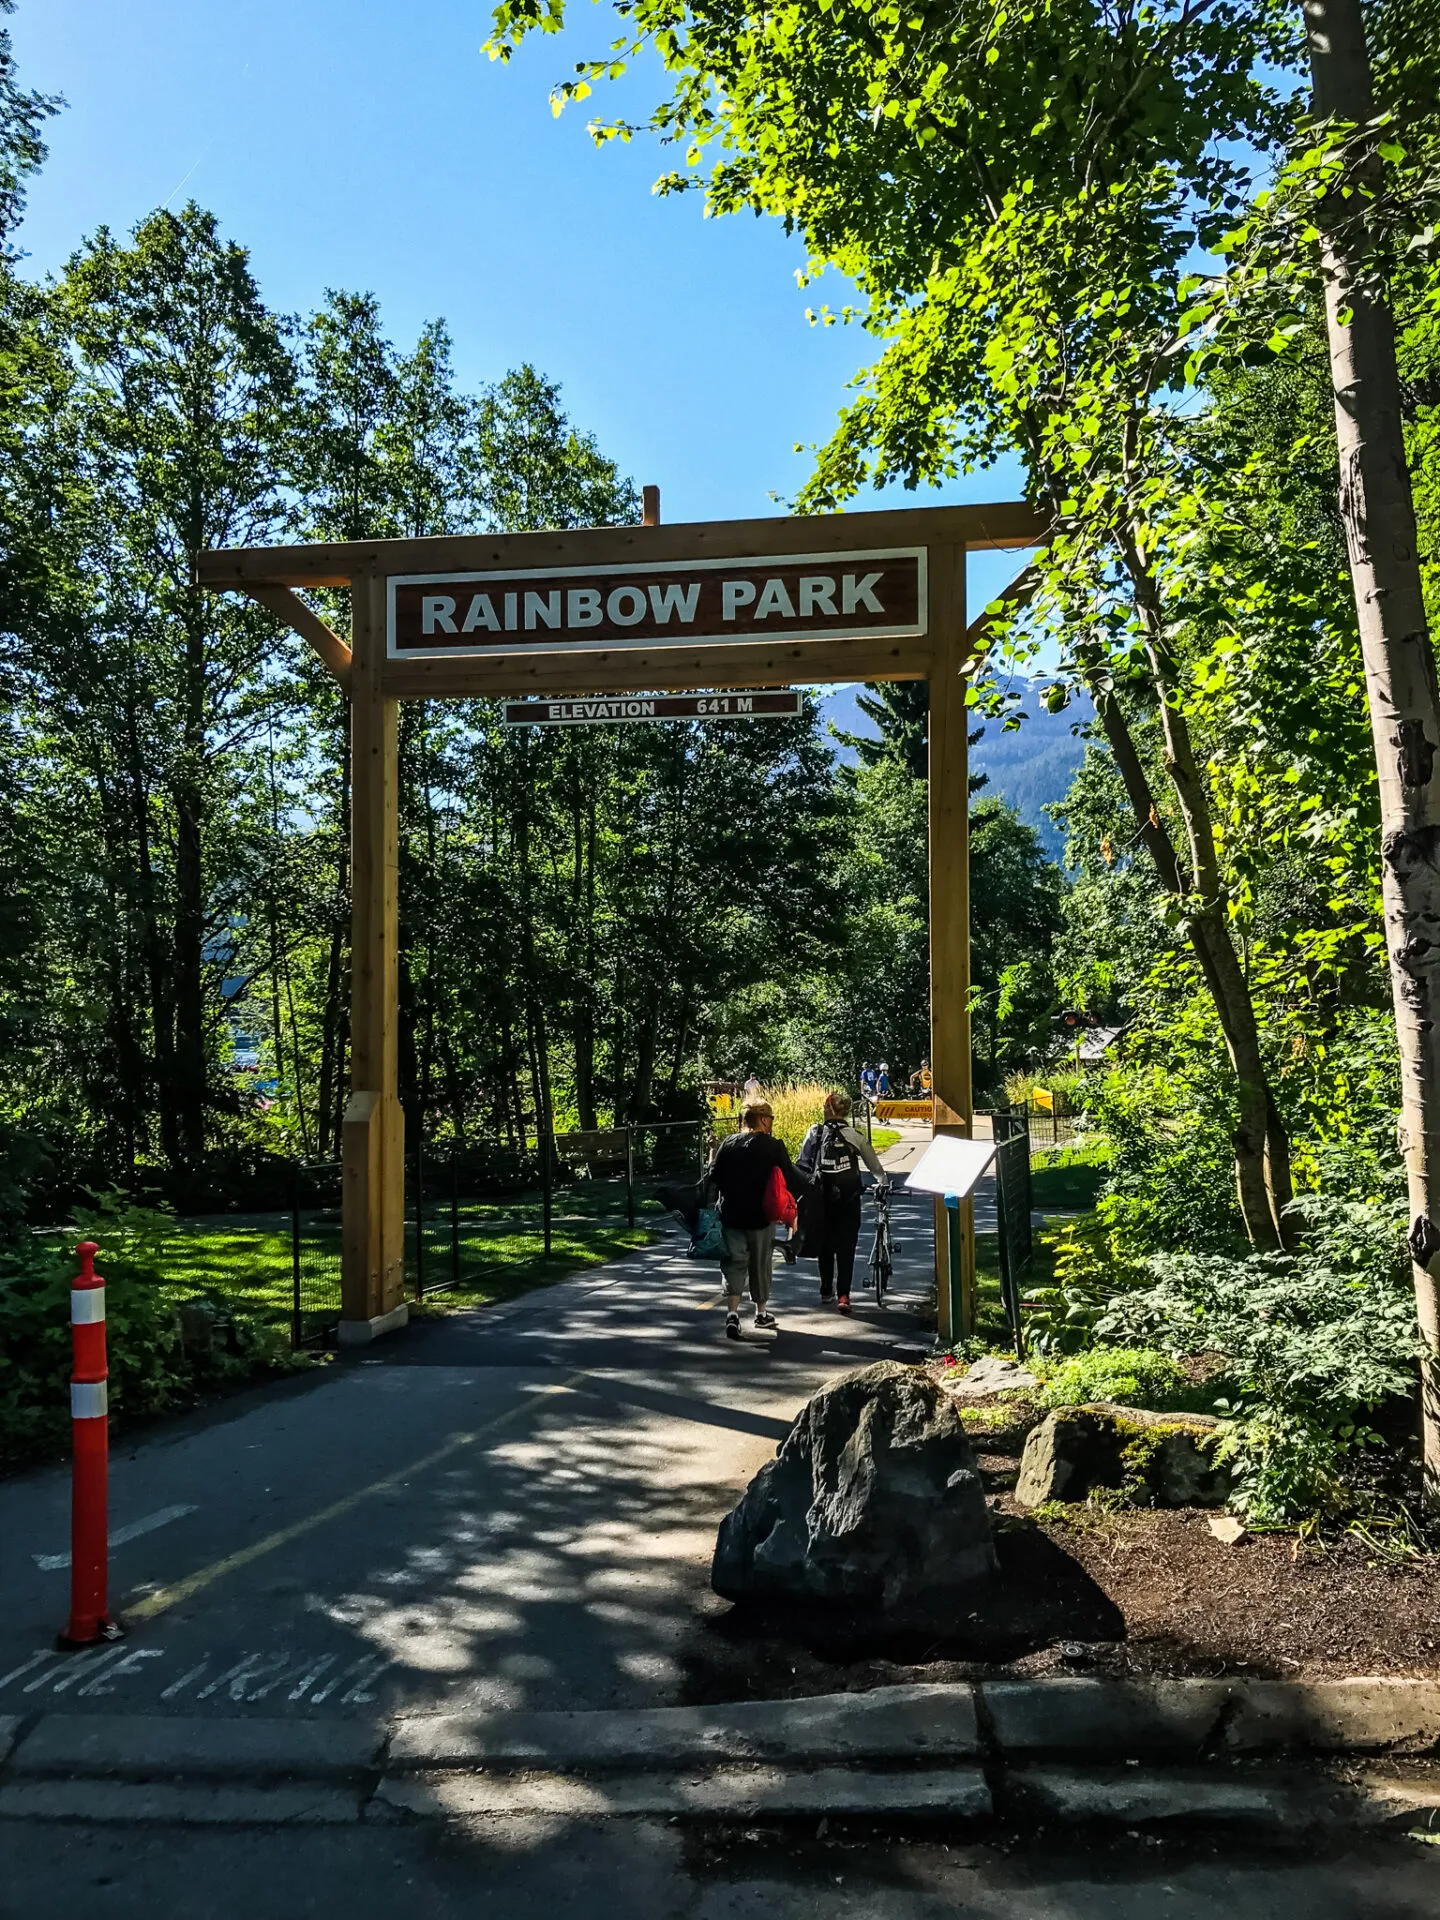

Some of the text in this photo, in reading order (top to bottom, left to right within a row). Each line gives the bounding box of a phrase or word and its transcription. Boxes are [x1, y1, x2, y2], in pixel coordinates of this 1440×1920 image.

[422, 572, 885, 635] RAINBOW PARK
[549, 697, 753, 719] ELEVATION 641 M
[0, 1645, 164, 1696] THE
